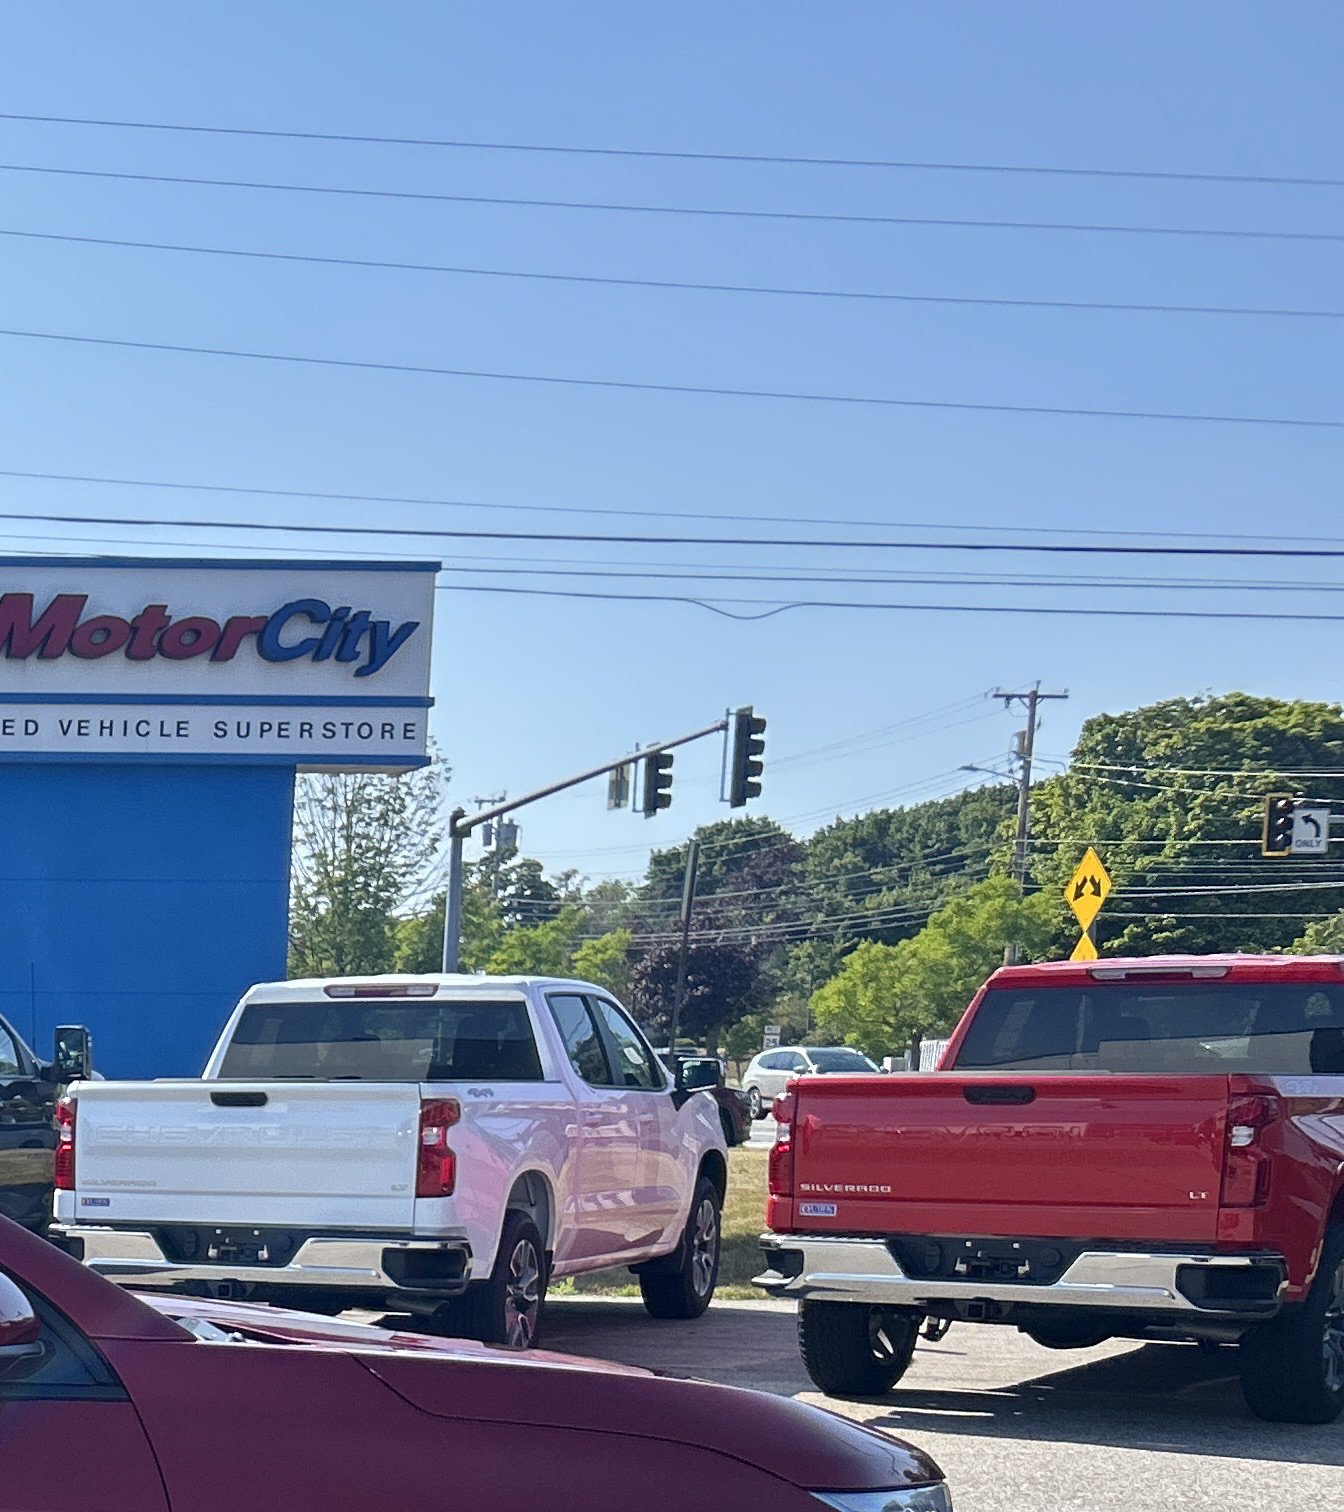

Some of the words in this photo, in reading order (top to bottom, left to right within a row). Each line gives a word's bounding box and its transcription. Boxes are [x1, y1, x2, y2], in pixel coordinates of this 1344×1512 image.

[59, 718, 190, 738] VEHICLE
[213, 719, 417, 741] SUPERSTORE
[1295, 838, 1322, 848] ONLY
[800, 1183, 891, 1193] SILVERADO
[1189, 1191, 1208, 1199] LT
